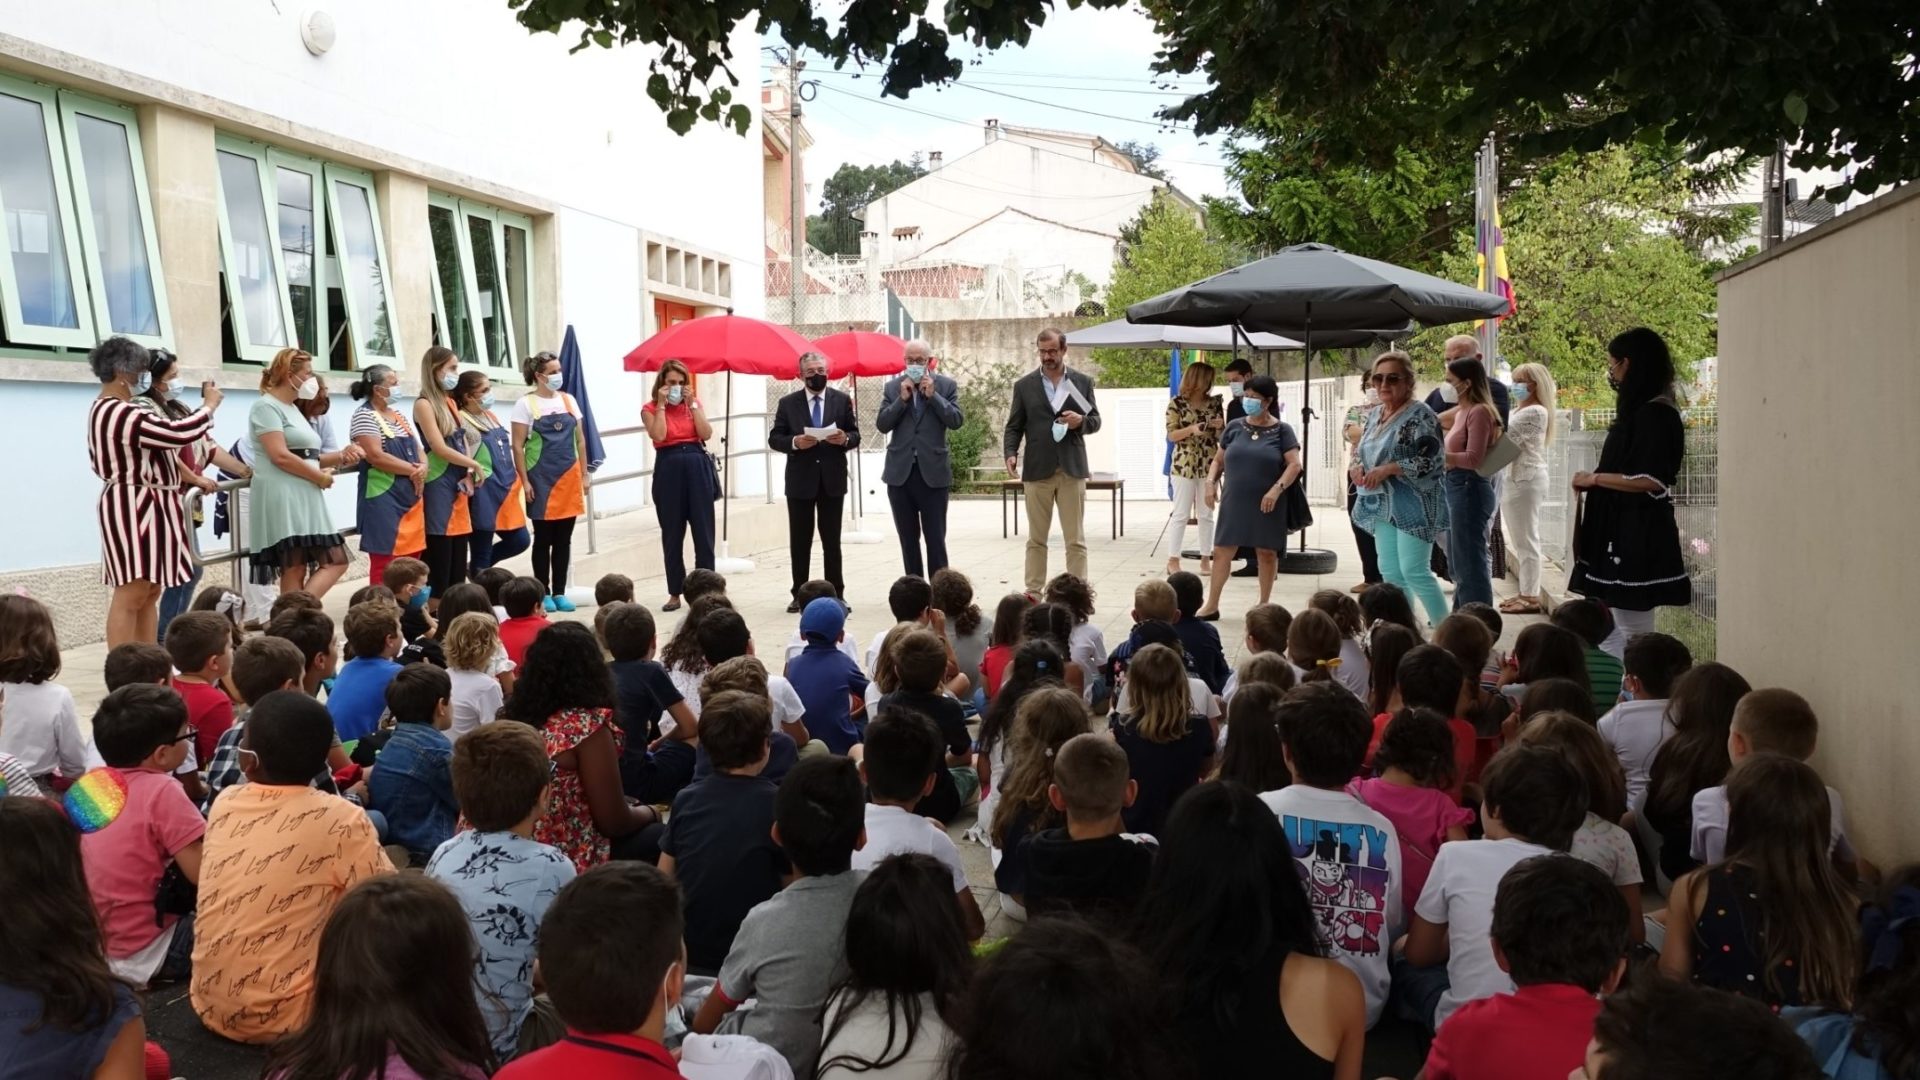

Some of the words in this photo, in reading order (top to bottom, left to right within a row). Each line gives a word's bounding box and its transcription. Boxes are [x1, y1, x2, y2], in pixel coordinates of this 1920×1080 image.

[1276, 814, 1388, 870] UFFY
[244, 844, 300, 876] Legacy
[241, 923, 292, 956] Legacy
